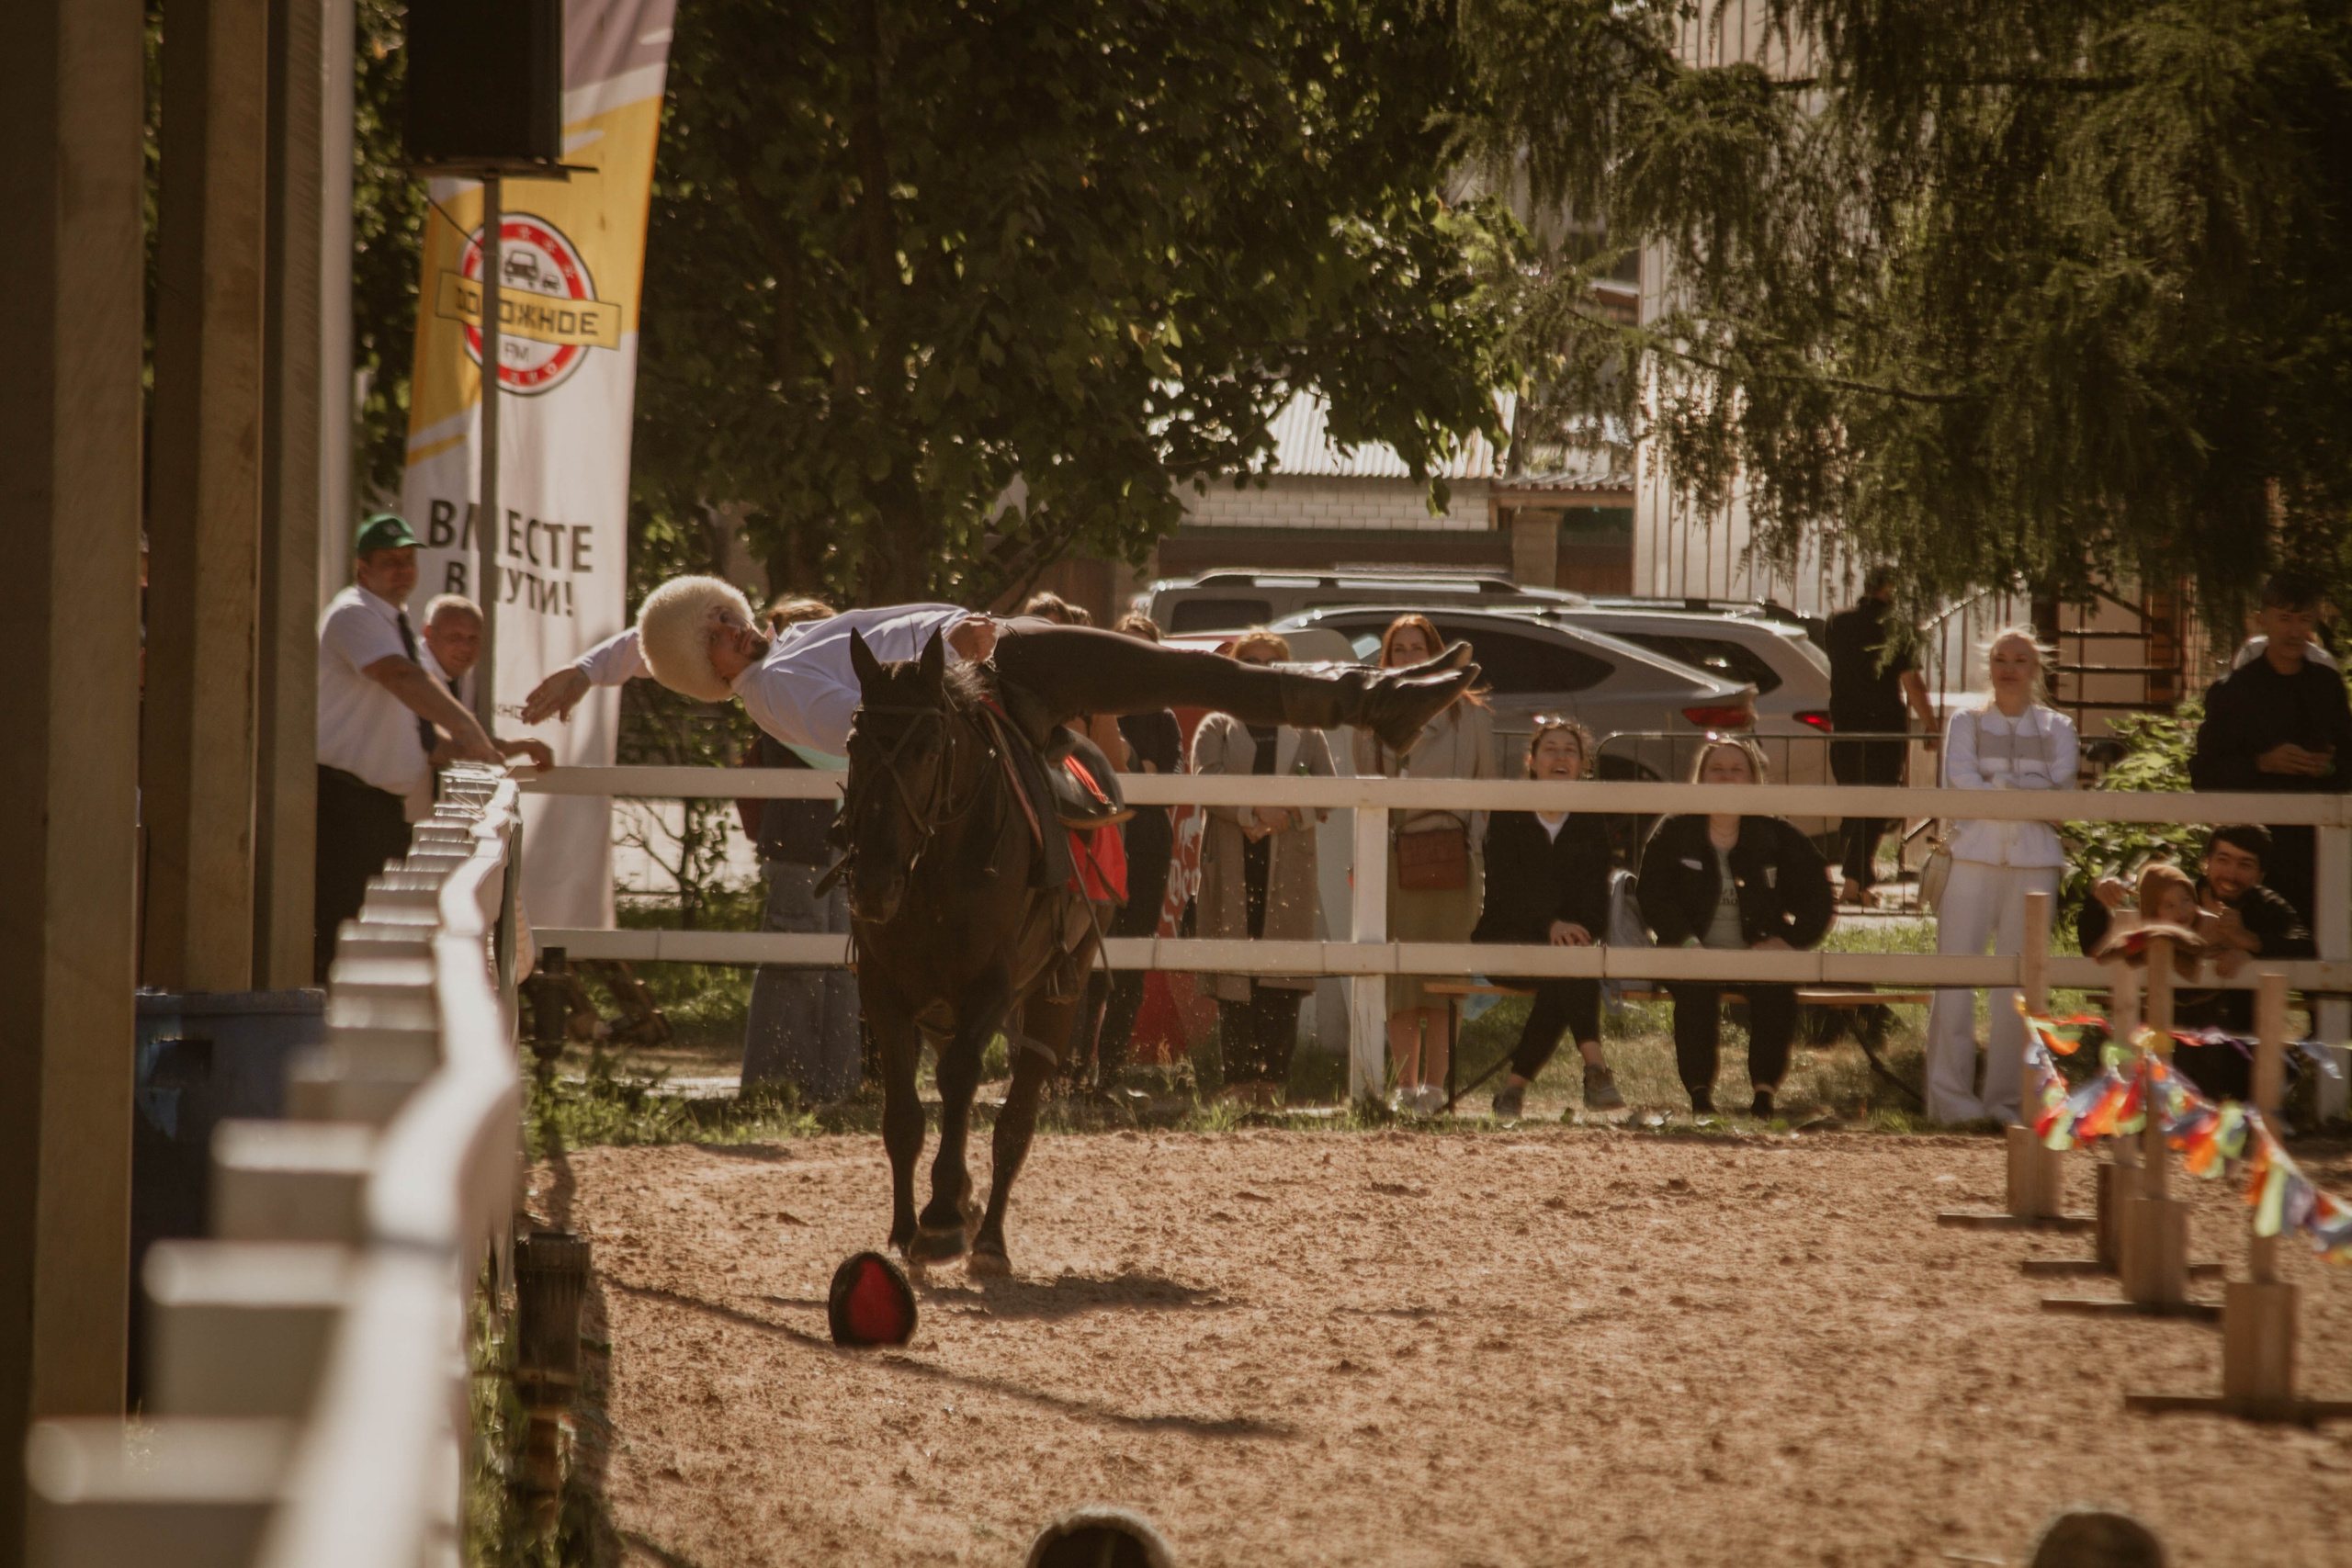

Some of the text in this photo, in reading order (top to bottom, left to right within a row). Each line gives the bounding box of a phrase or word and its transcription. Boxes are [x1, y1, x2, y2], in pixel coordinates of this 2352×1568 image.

[456, 286, 599, 336] ДООЖНОЕ
[447, 560, 574, 619] В УТИ!
